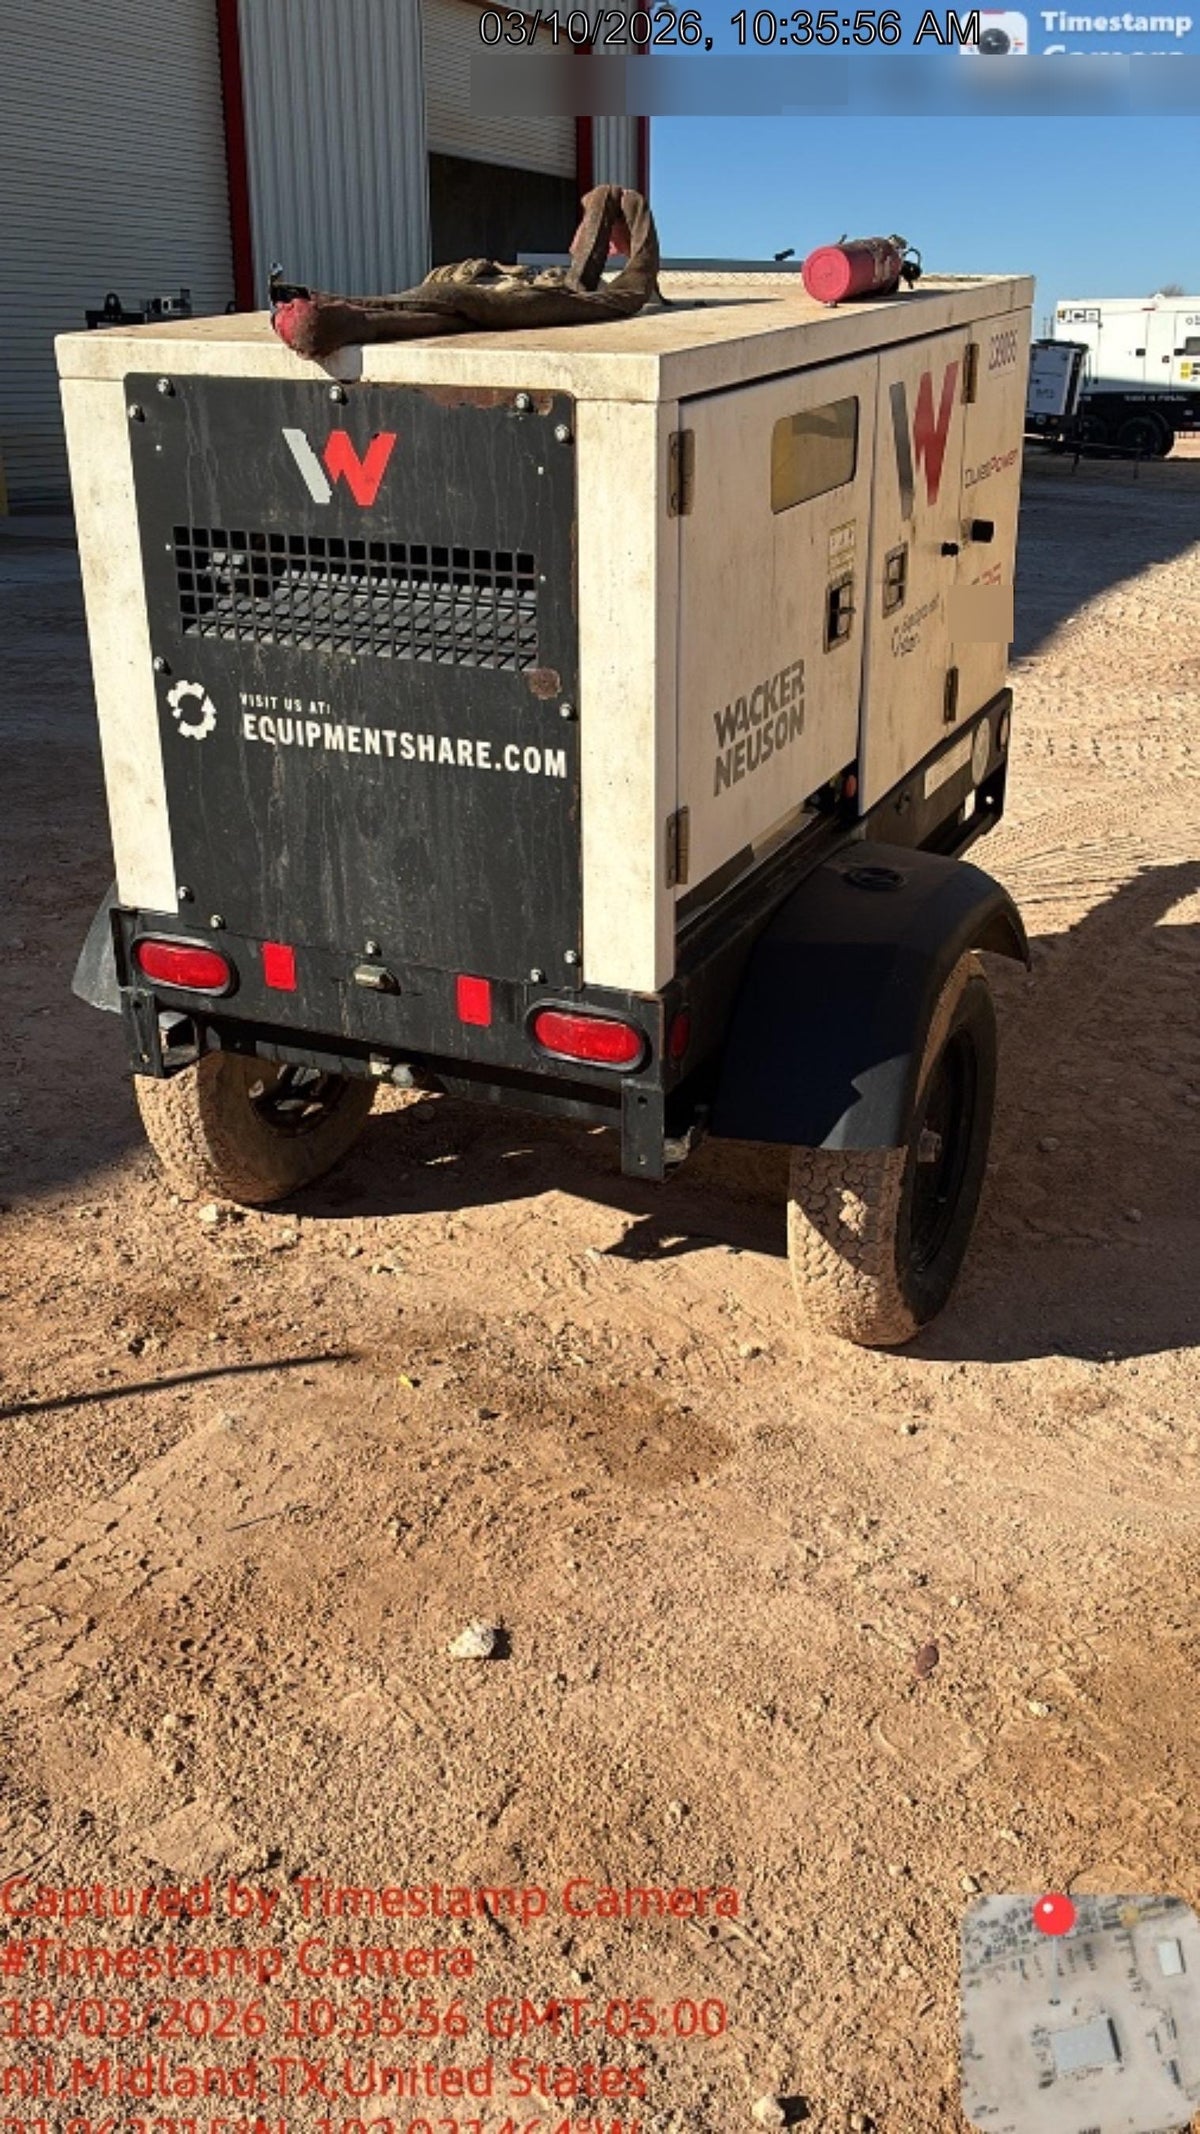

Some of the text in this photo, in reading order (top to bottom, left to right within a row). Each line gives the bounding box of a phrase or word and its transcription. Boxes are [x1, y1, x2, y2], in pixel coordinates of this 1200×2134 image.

[239, 691, 279, 710] VISIT
[283, 697, 303, 712] US
[713, 658, 805, 749] WACKER
[242, 713, 568, 778] EQUIPMENTSHARE.COM
[713, 698, 805, 798] NEUSON
